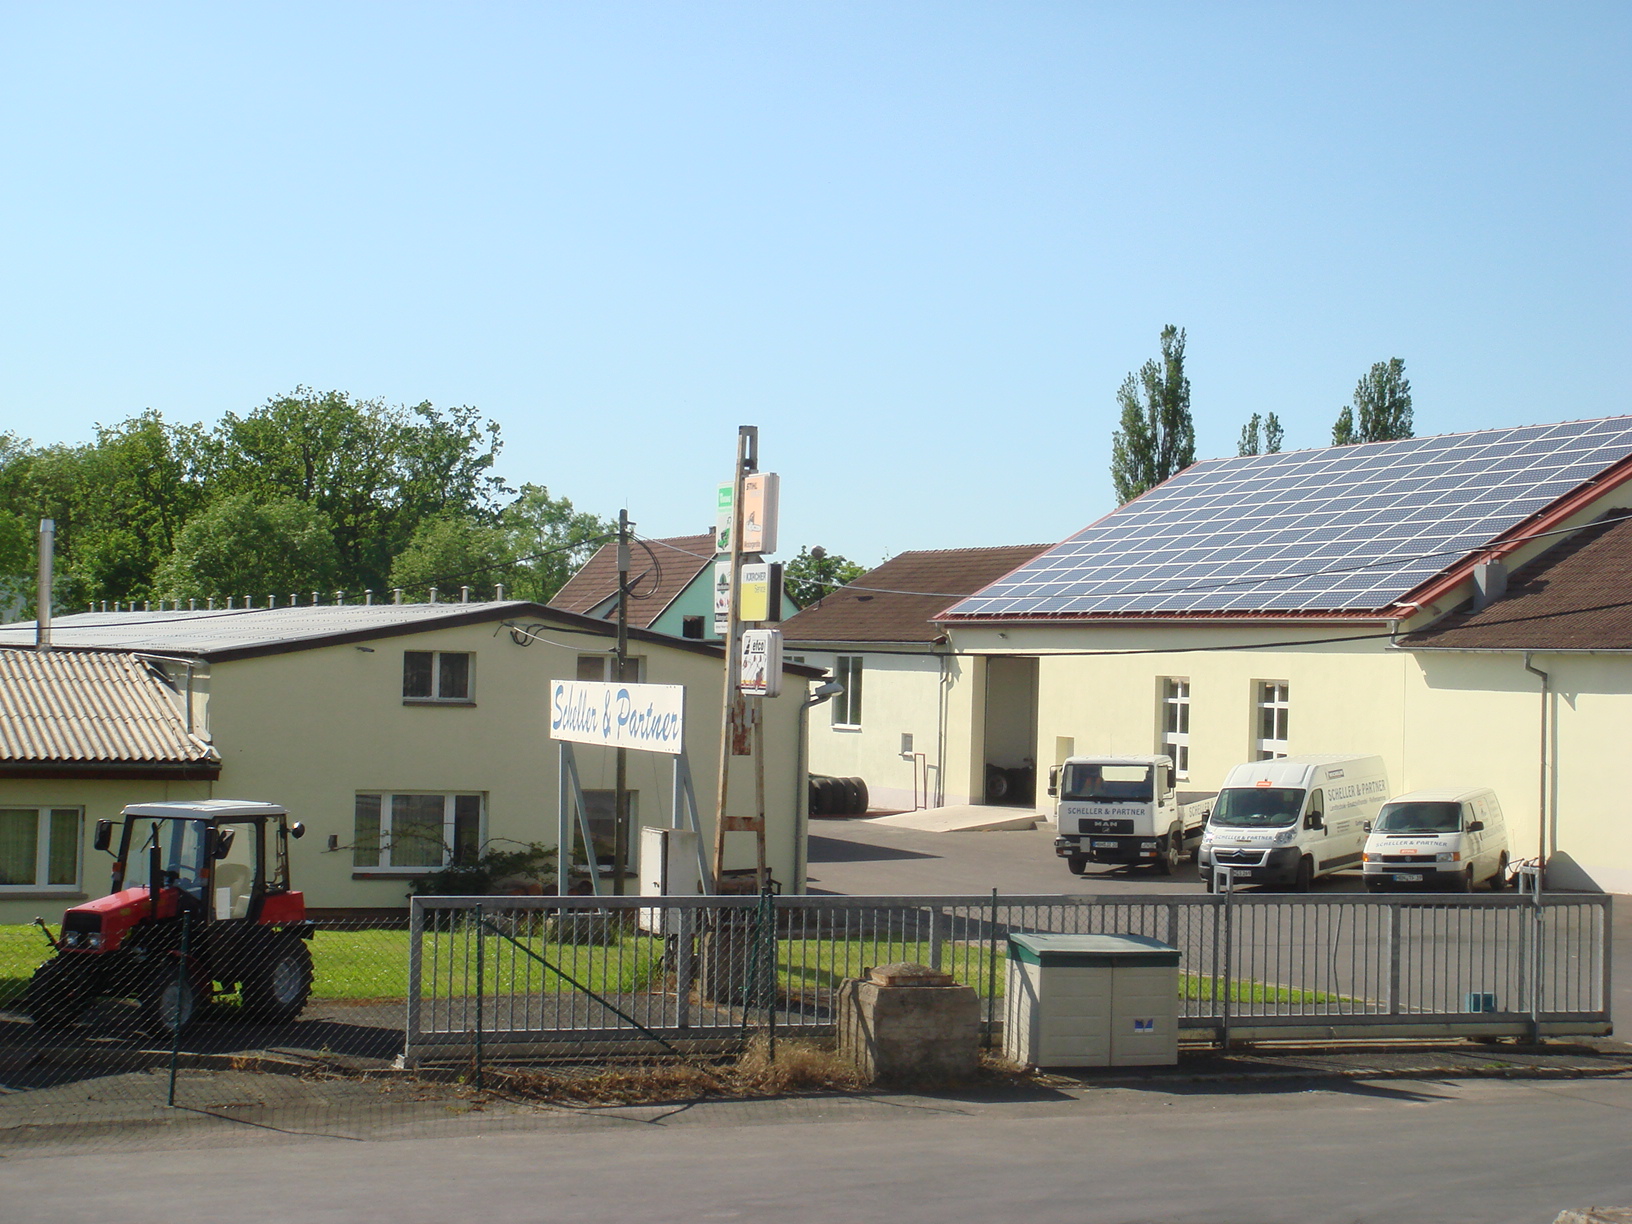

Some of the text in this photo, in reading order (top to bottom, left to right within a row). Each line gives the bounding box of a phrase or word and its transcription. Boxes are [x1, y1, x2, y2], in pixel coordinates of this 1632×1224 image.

[752, 640, 764, 651] efco
[553, 685, 679, 742] Scheller & Partner
[1327, 785, 1356, 801] SCHELLER
[1362, 780, 1386, 795] PARTNER
[1067, 807, 1145, 816] SCHELLER & PARTNER
[1375, 840, 1408, 848] SCHELLER
